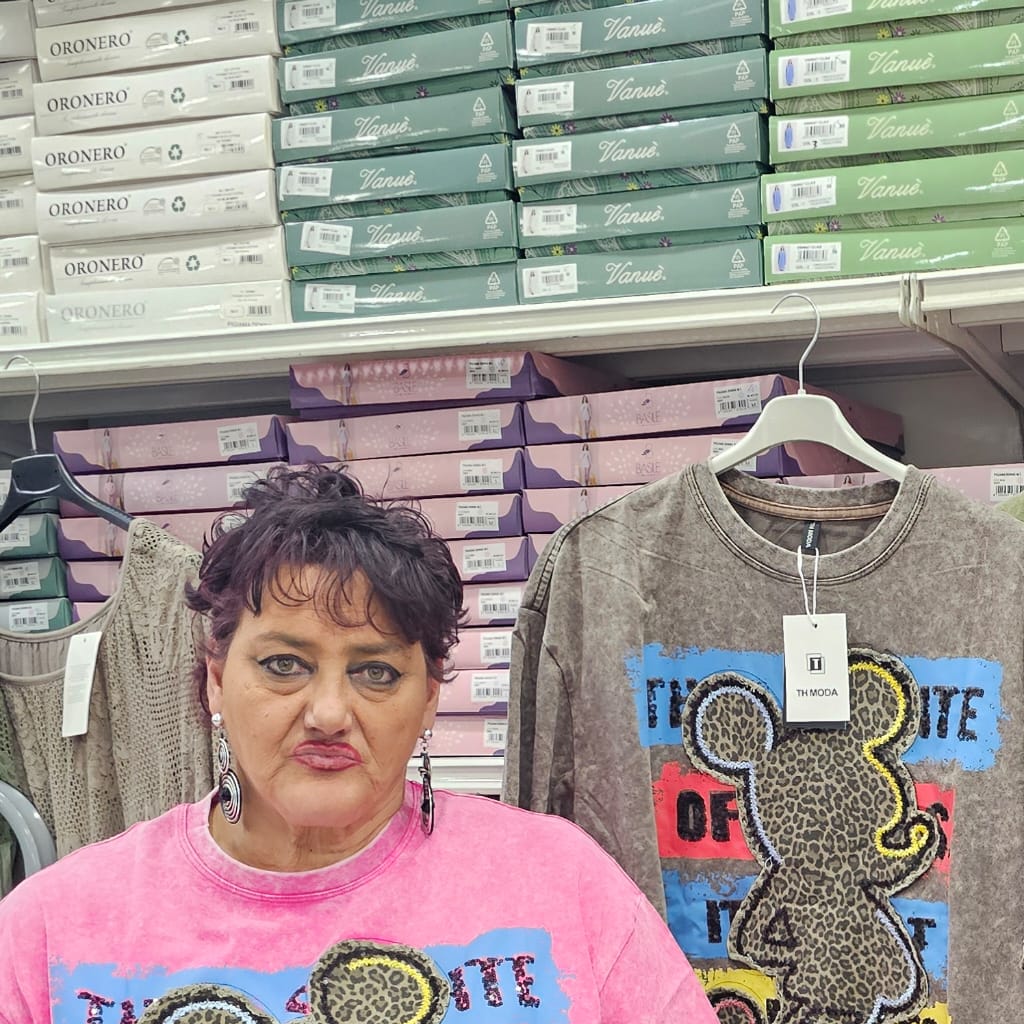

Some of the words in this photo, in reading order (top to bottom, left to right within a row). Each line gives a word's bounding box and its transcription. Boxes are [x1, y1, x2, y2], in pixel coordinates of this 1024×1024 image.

[604, 16, 663, 40] Vanuè
[50, 32, 132, 57] ORONERO
[868, 50, 932, 75] Vanuè
[47, 89, 128, 112] ORONERO
[607, 77, 666, 102] Vanuè
[867, 116, 931, 140] Vanuè
[45, 145, 125, 167] ORONERO
[599, 140, 657, 163] Vanuè
[360, 168, 415, 190] Vanuè
[857, 176, 922, 199] Vanuè
[49, 197, 129, 217] ORONERO
[604, 203, 663, 226] Vanuè
[860, 239, 924, 262] Vanuè
[64, 255, 144, 276] ORONERO
[606, 262, 664, 285] Vanuè
[61, 302, 146, 322] ORONERO
[796, 689, 808, 697] TH
[810, 689, 838, 697] MODA
